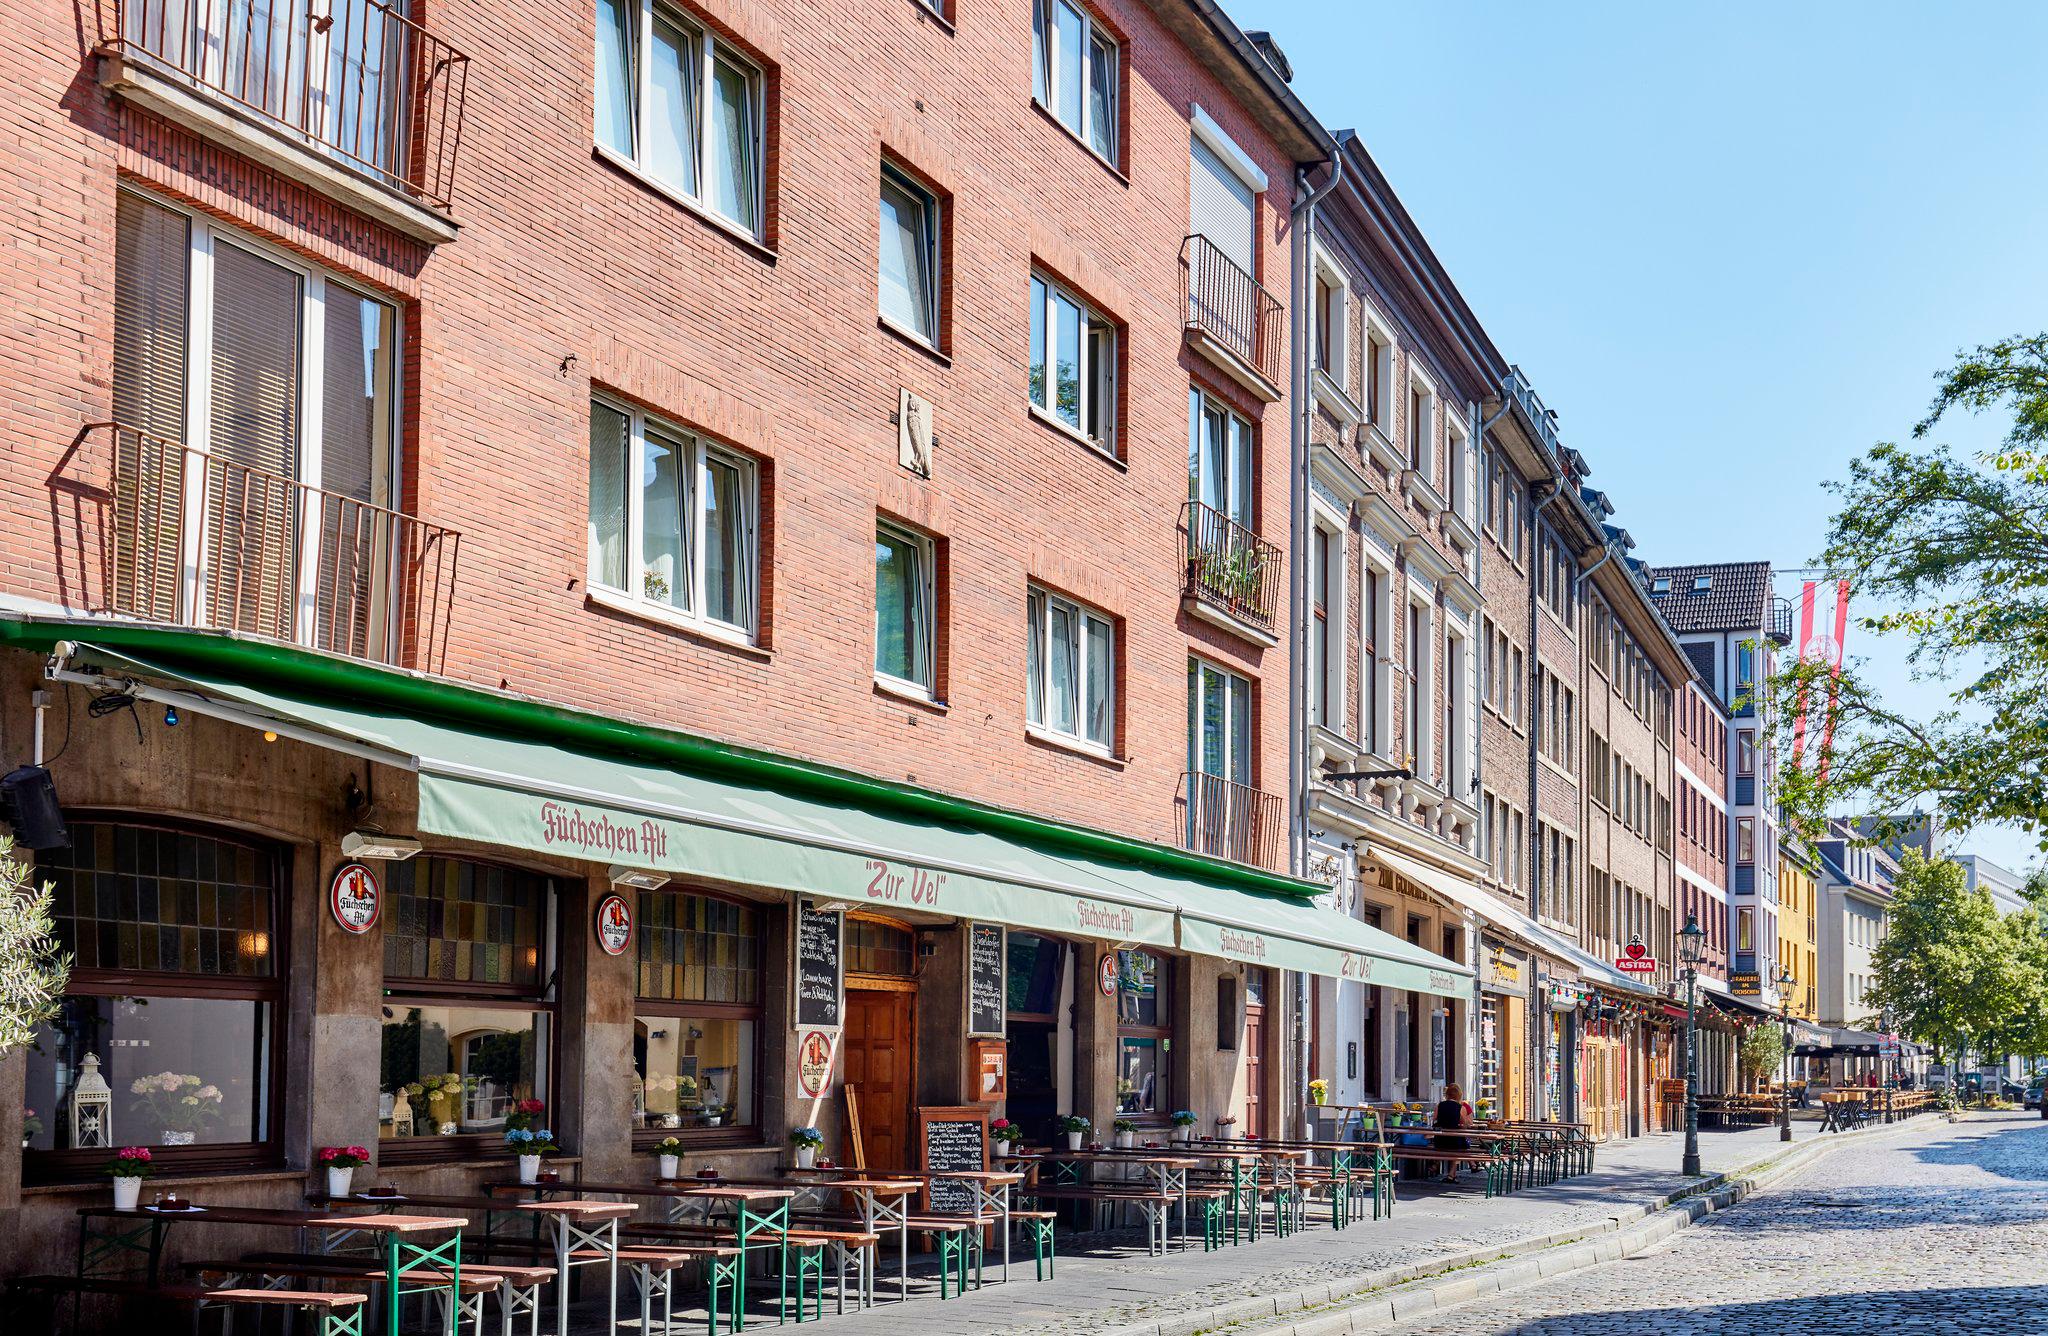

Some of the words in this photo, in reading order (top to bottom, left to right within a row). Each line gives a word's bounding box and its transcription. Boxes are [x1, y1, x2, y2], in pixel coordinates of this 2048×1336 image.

[541, 801, 638, 858] Füchschen
[641, 819, 667, 866] Alt
[1077, 899, 1121, 933] Füchschen
[1121, 907, 1134, 938] Alt
[1618, 961, 1654, 969] ASTRA
